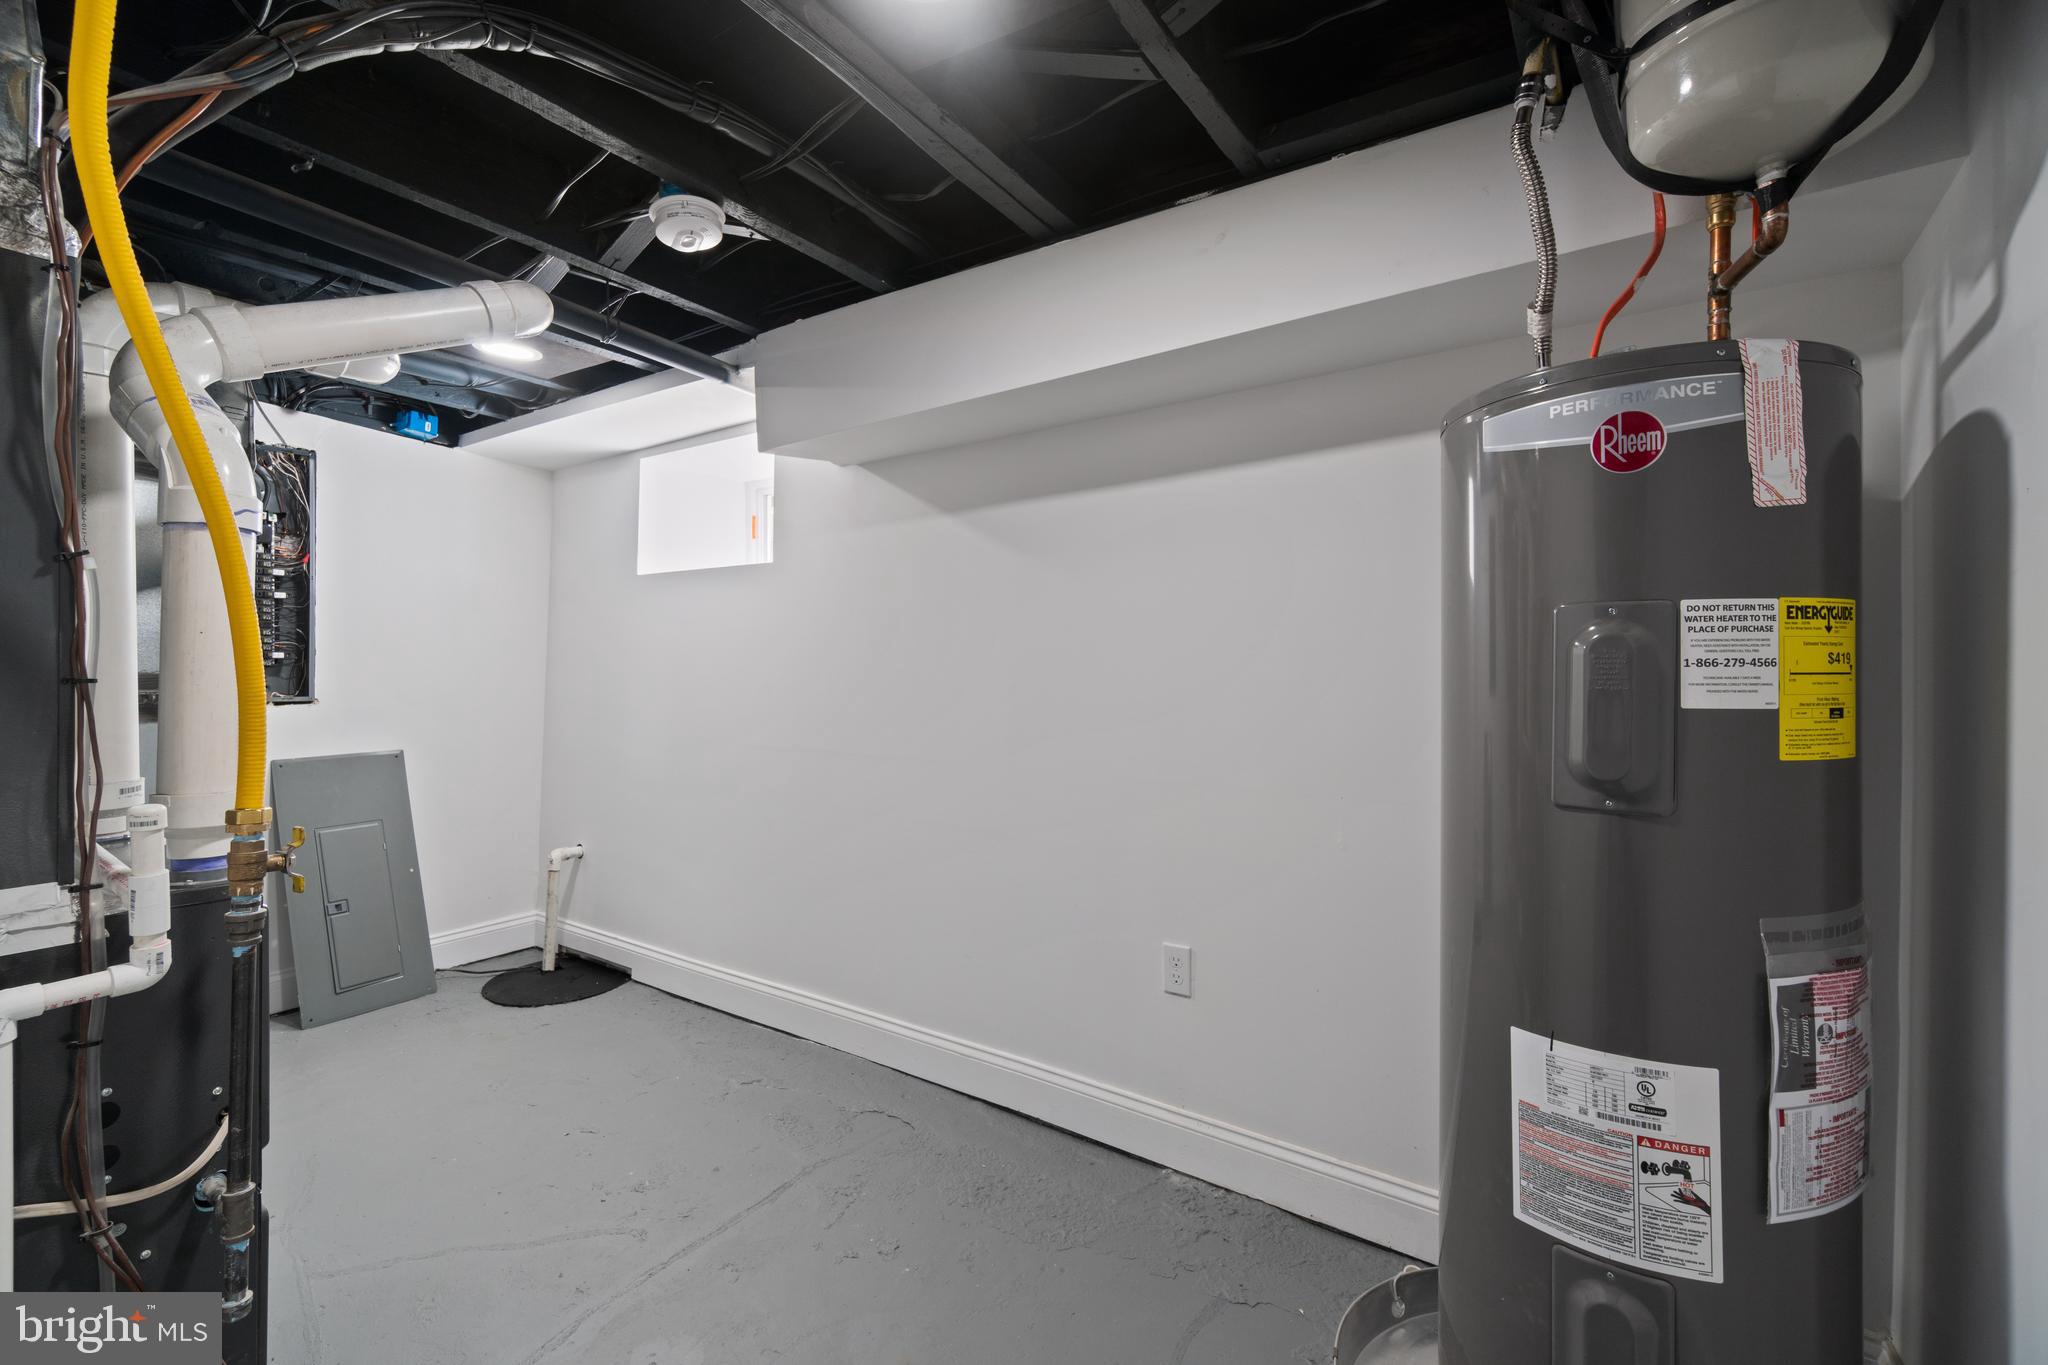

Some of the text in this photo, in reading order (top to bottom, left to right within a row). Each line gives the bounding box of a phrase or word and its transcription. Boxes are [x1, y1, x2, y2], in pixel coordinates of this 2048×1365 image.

[1601, 413, 1661, 463] Rheem
[1786, 605, 1853, 621] ENERGYGUIDE
[1684, 658, 1777, 668] 1-866-279-4566
[1828, 652, 1850, 664] $419
[1790, 1017, 1800, 1054] Limited
[1641, 1084, 1652, 1094] UL
[1607, 1128, 1633, 1137] CAUTION
[1655, 1140, 1705, 1154] DANGER
